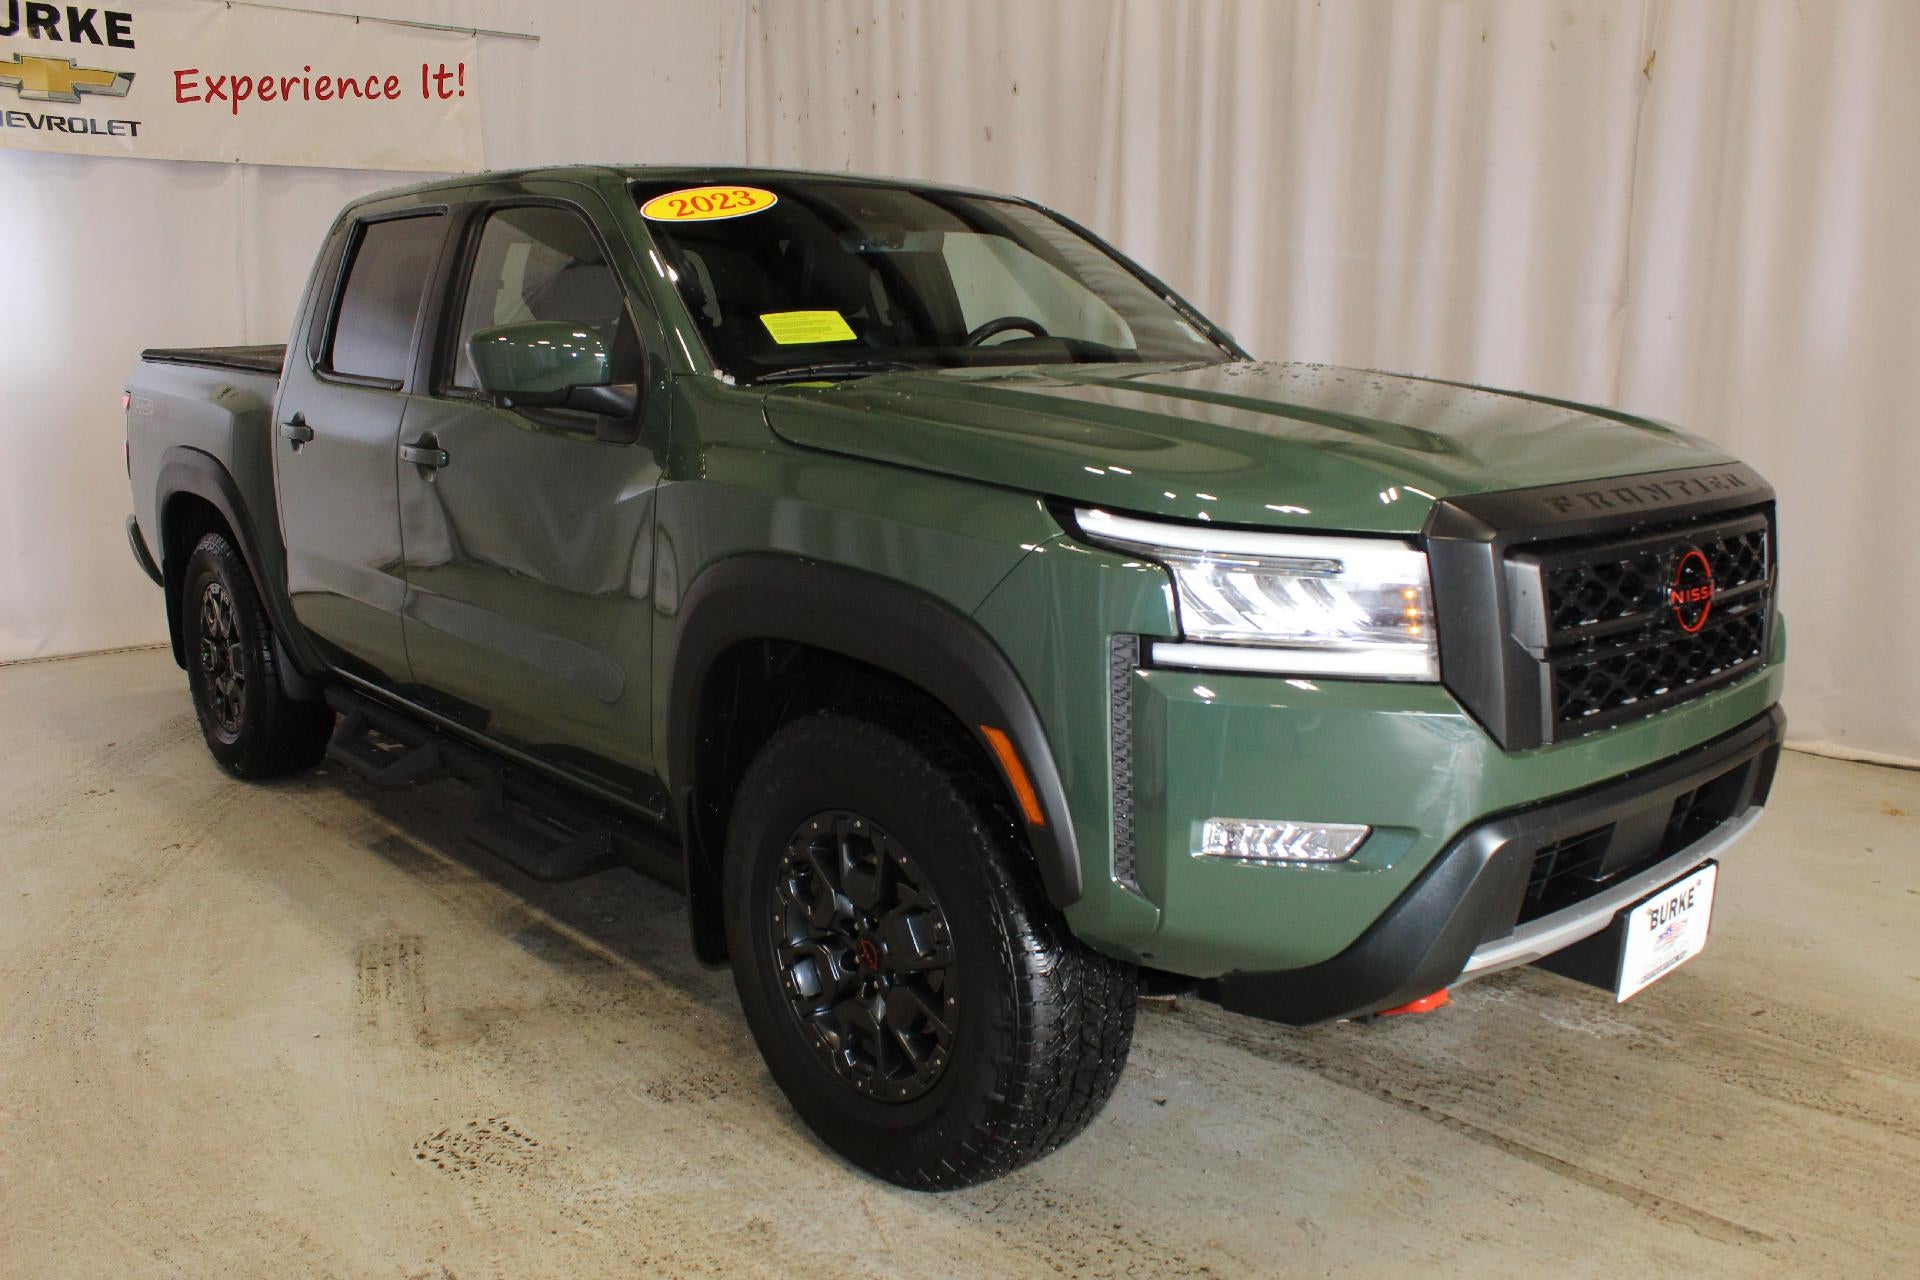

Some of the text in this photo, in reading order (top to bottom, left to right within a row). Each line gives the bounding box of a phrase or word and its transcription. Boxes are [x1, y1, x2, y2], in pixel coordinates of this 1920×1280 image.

[173, 62, 466, 115] Experience It!
[668, 190, 756, 218] 2023
[1541, 473, 1747, 513] FRONTIER
[1650, 887, 1695, 931] BURKE
